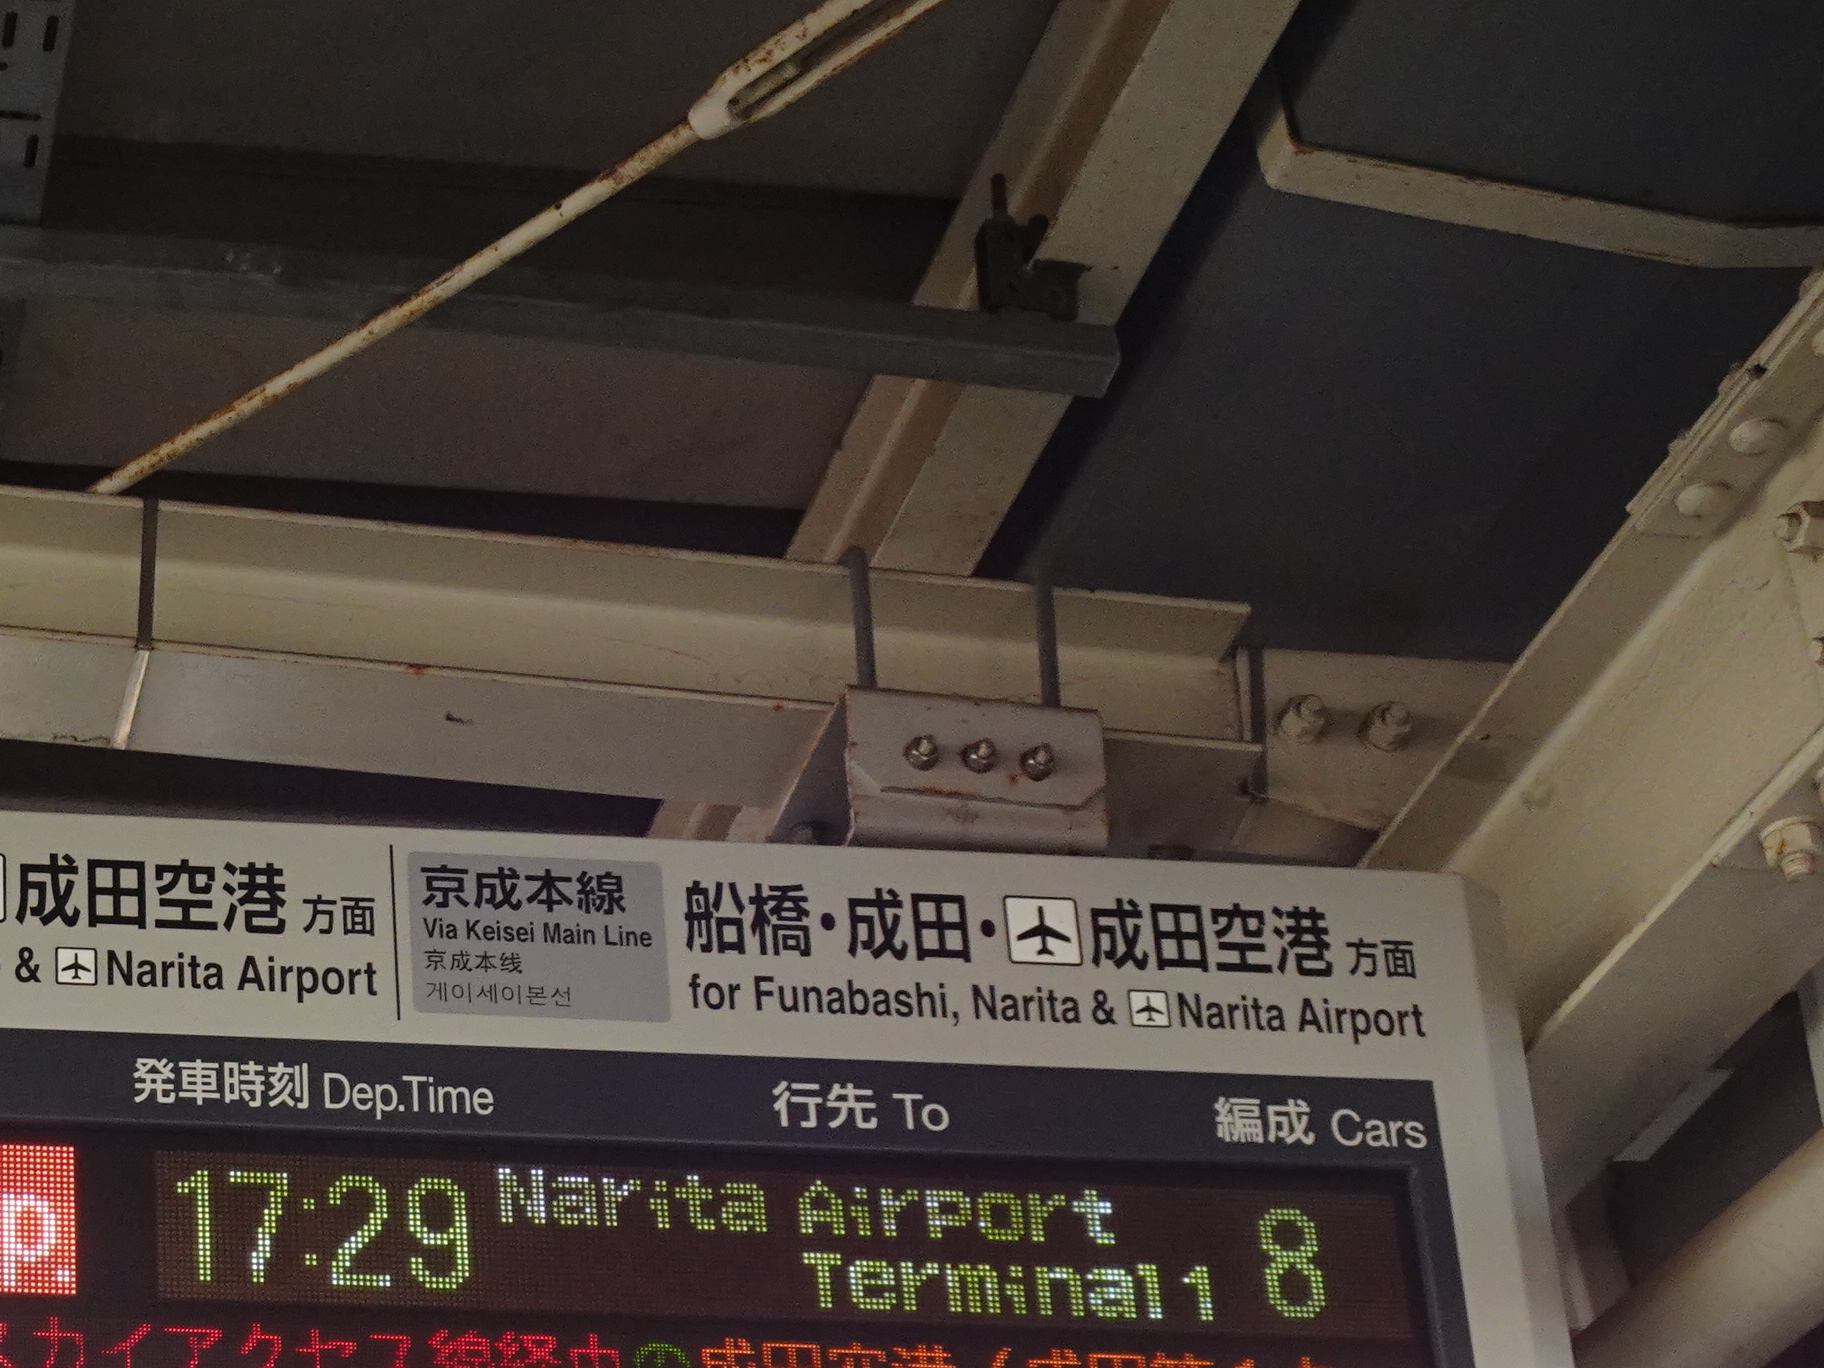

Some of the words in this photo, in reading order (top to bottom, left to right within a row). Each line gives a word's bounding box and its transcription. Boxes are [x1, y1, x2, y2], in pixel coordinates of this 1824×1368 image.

[421, 864, 627, 916] 京成本線
[423, 917, 459, 941] Via
[466, 919, 535, 944] Keisei
[543, 922, 597, 947] Main
[604, 925, 653, 948] Line
[15, 947, 43, 984] &
[107, 949, 225, 991] Narita
[237, 955, 378, 1004] Airport
[424, 949, 524, 974] 京成本线
[689, 973, 742, 1011] for
[754, 974, 961, 1027] Funabashi,
[972, 984, 1082, 1024] Narita
[1092, 989, 1118, 1026] &
[1178, 992, 1286, 1033] Narita
[1299, 997, 1428, 1046] Airport
[132, 1057, 309, 1111] 発車時刻
[772, 1080, 878, 1130] 行先
[892, 1092, 950, 1132] To
[1213, 1095, 1316, 1147] 編成
[1330, 1108, 1428, 1149] Cars
[175, 1168, 472, 1290] 17:29
[496, 1166, 769, 1234] Narita
[797, 1179, 1117, 1246] Airport
[801, 1250, 1164, 1321] Terminal
[1181, 1264, 1215, 1323] 1
[1254, 1207, 1327, 1320] 8
